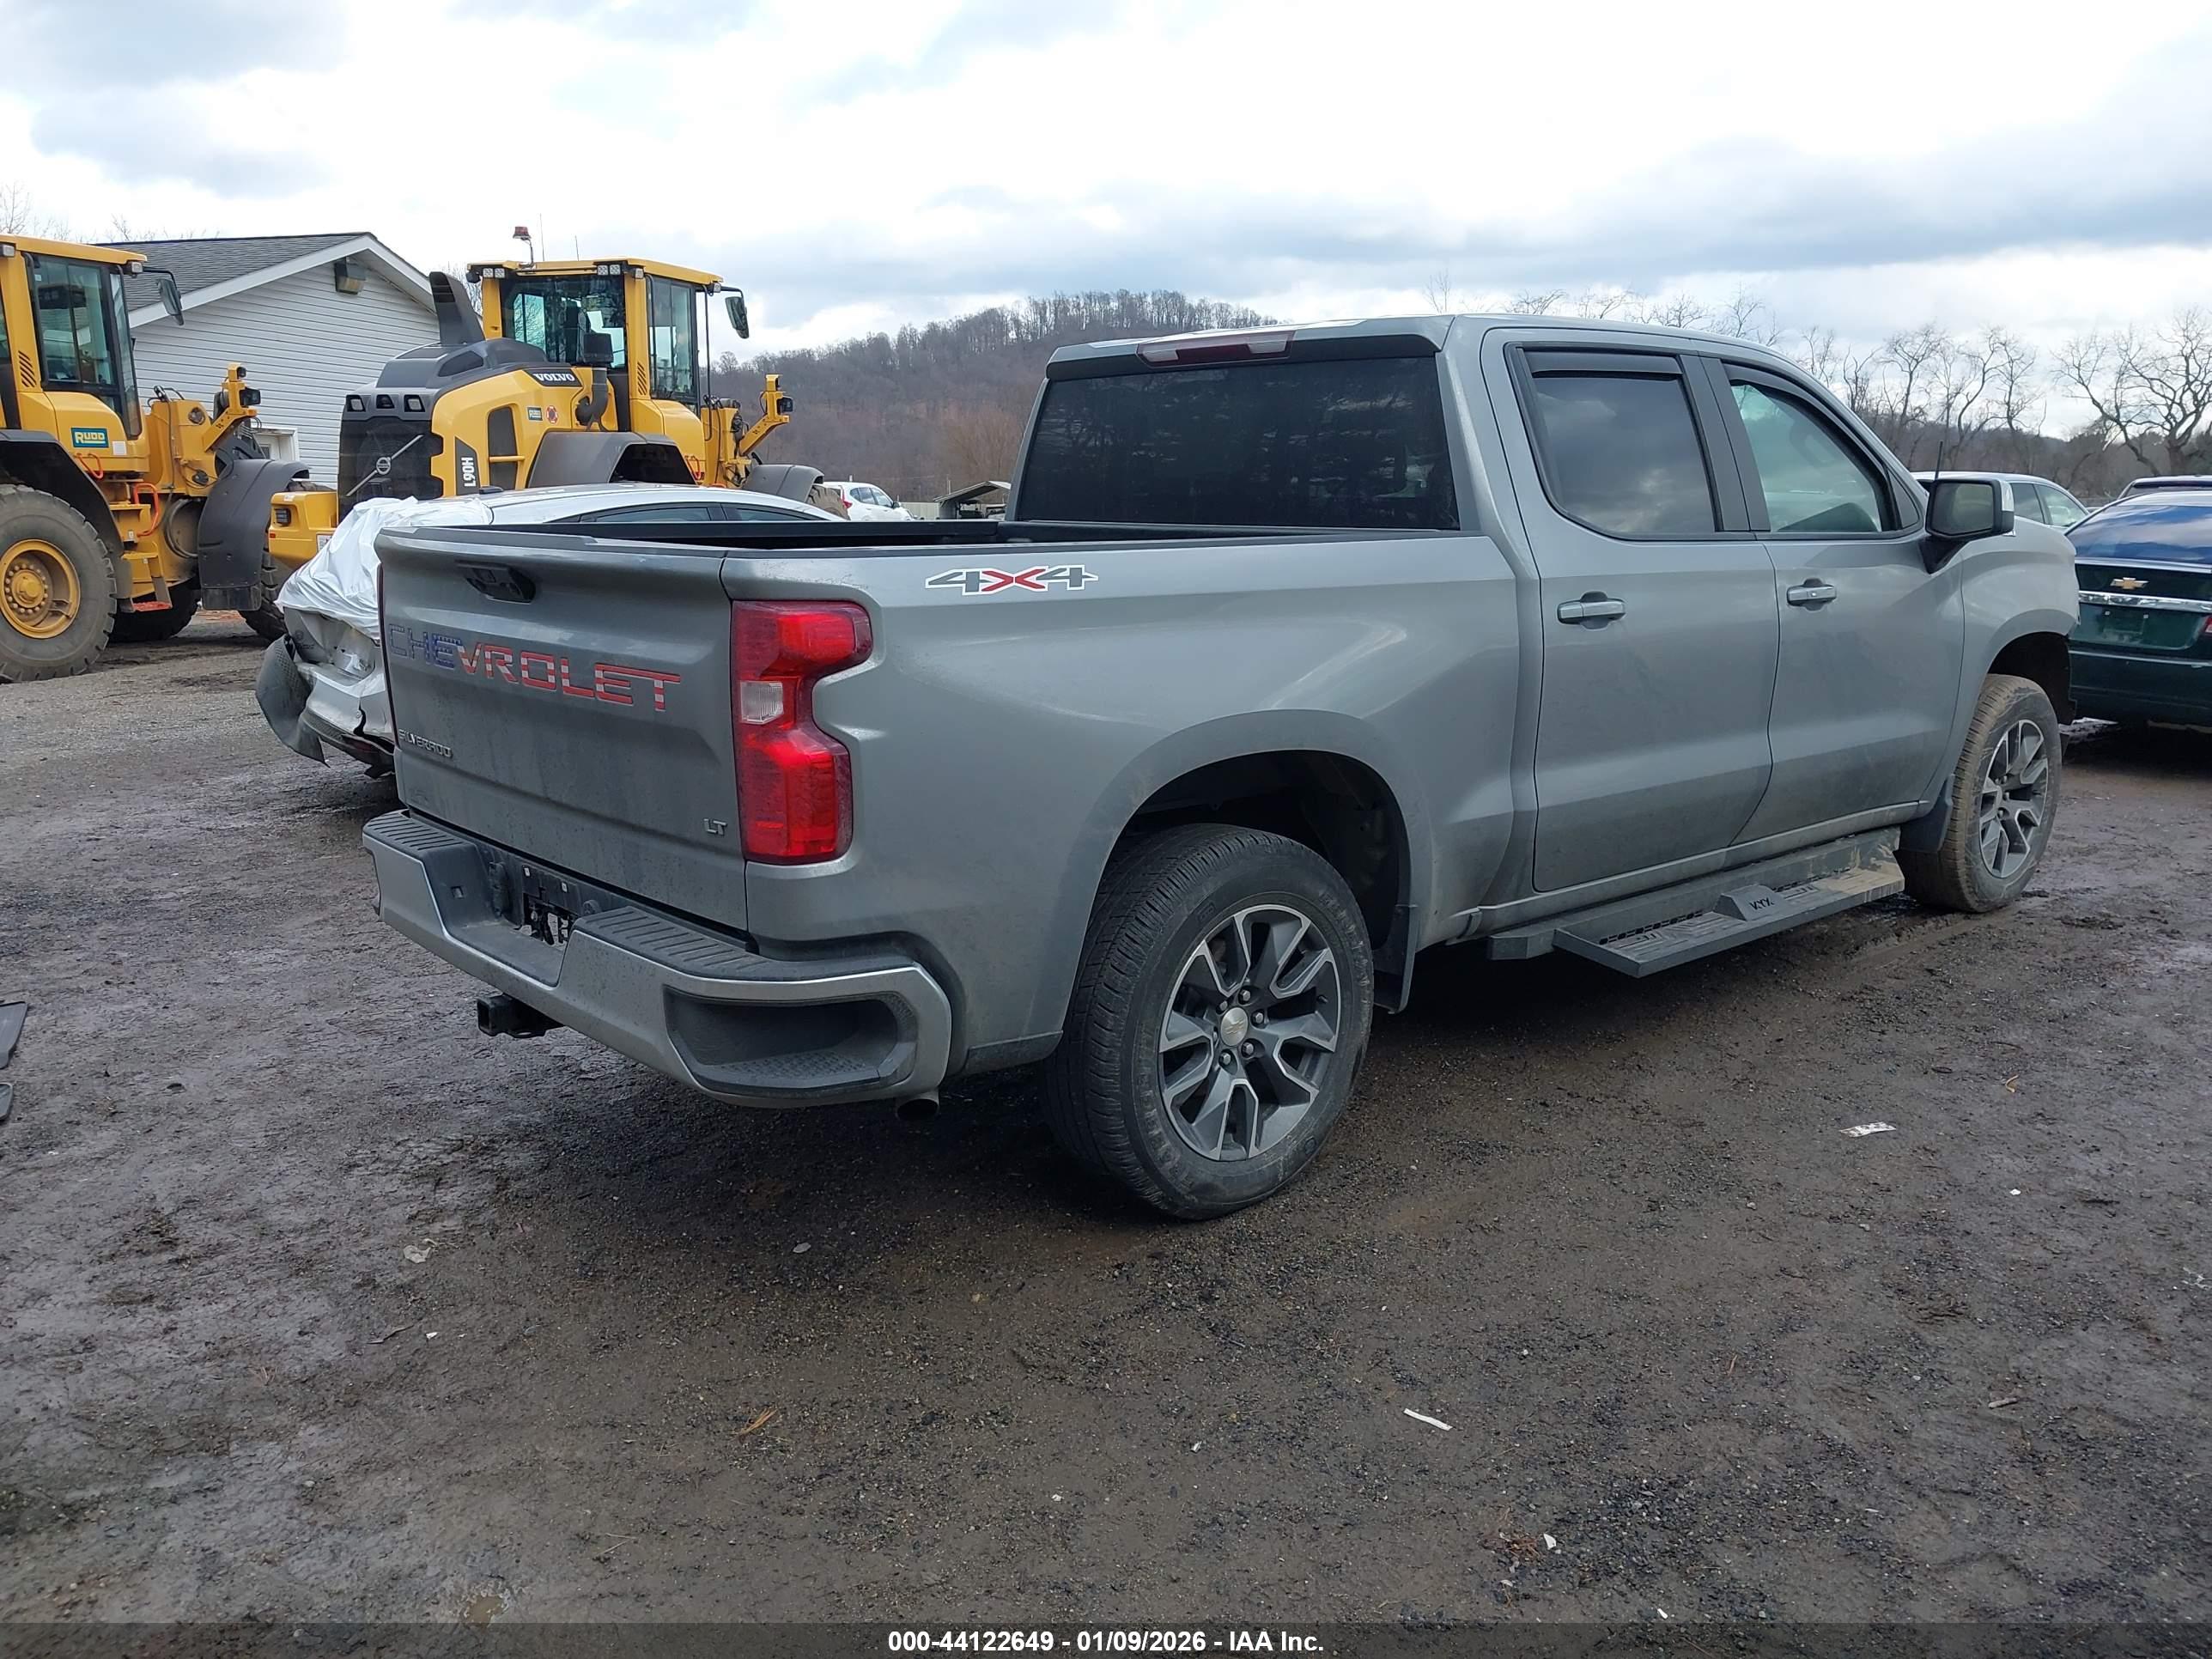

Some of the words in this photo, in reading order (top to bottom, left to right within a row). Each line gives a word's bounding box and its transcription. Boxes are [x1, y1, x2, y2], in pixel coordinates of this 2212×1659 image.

[532, 373, 575, 381] VOLVO
[74, 431, 106, 444] RUDD
[460, 457, 477, 487] L90H
[389, 623, 681, 712] CHEVROLET
[703, 818, 727, 836] LT
